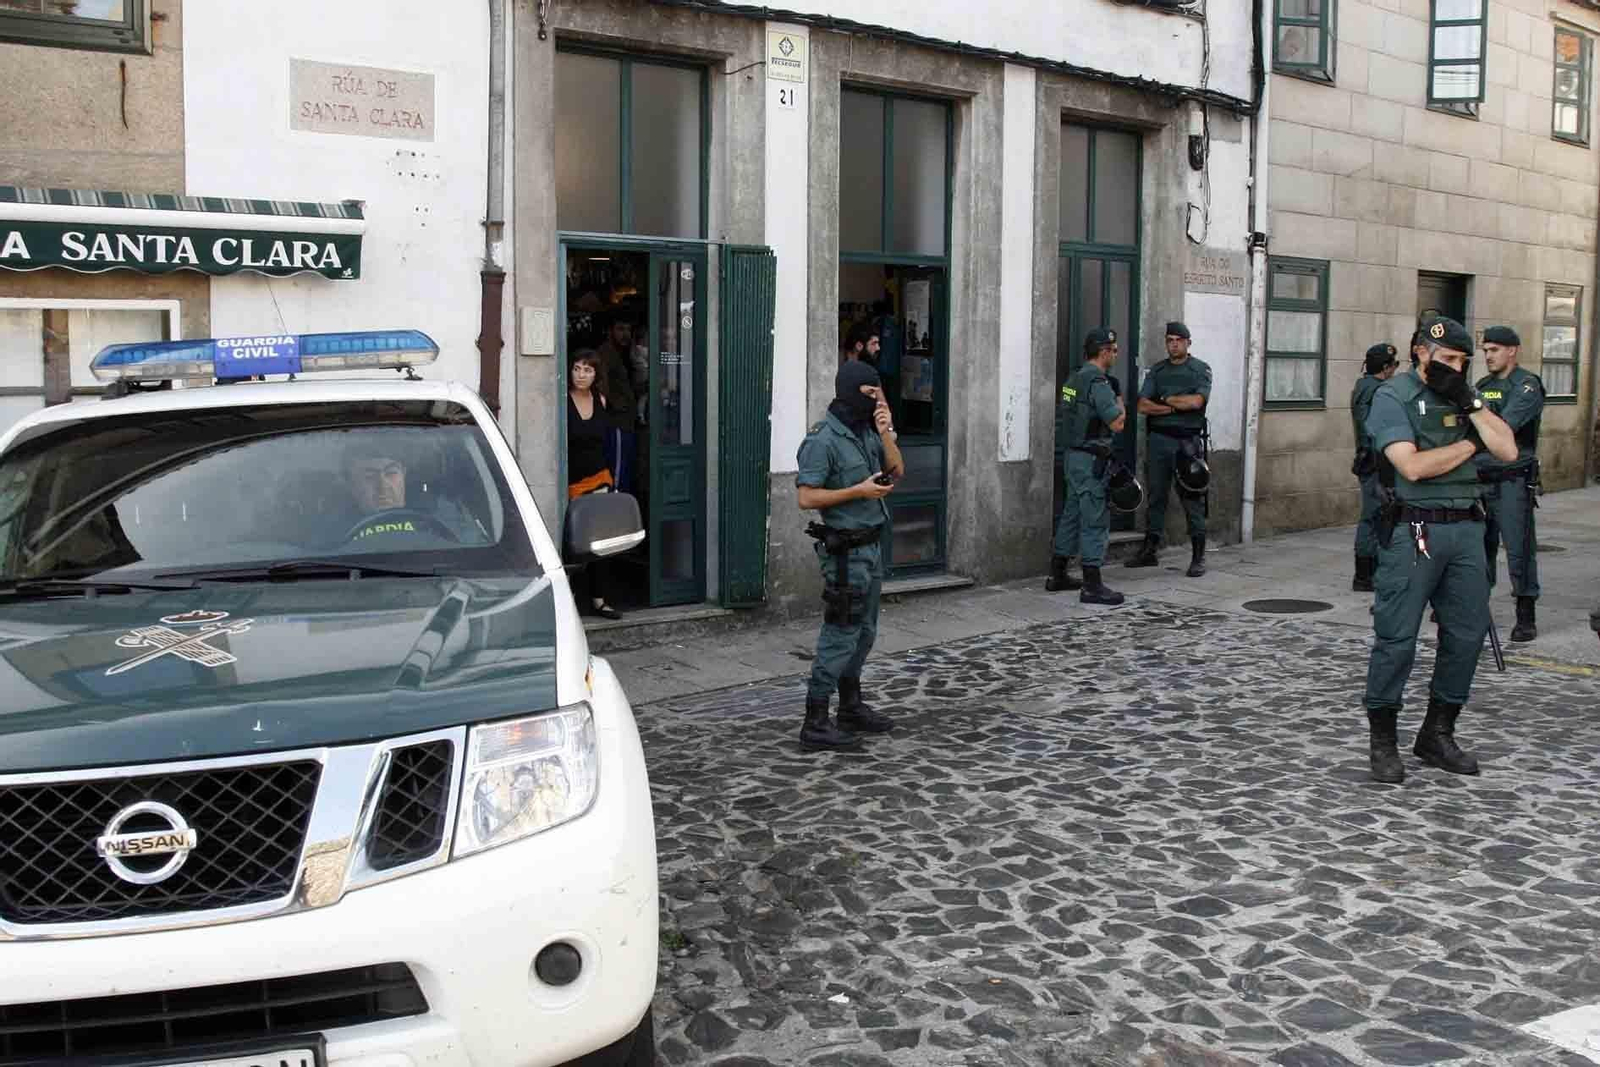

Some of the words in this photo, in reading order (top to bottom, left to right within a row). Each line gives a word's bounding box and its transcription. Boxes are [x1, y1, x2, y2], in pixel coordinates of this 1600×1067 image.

[331, 70, 368, 95] RÚA
[376, 81, 398, 98] DE
[780, 89, 793, 106] 21
[300, 101, 359, 123] SANTA
[369, 108, 425, 129] CLARA
[0, 231, 31, 259] A
[61, 231, 200, 265] SANTA
[212, 238, 343, 269] CLARA
[216, 335, 296, 348] GUARDIA
[232, 346, 279, 359] CIVIL
[105, 834, 185, 853] NISSAN
